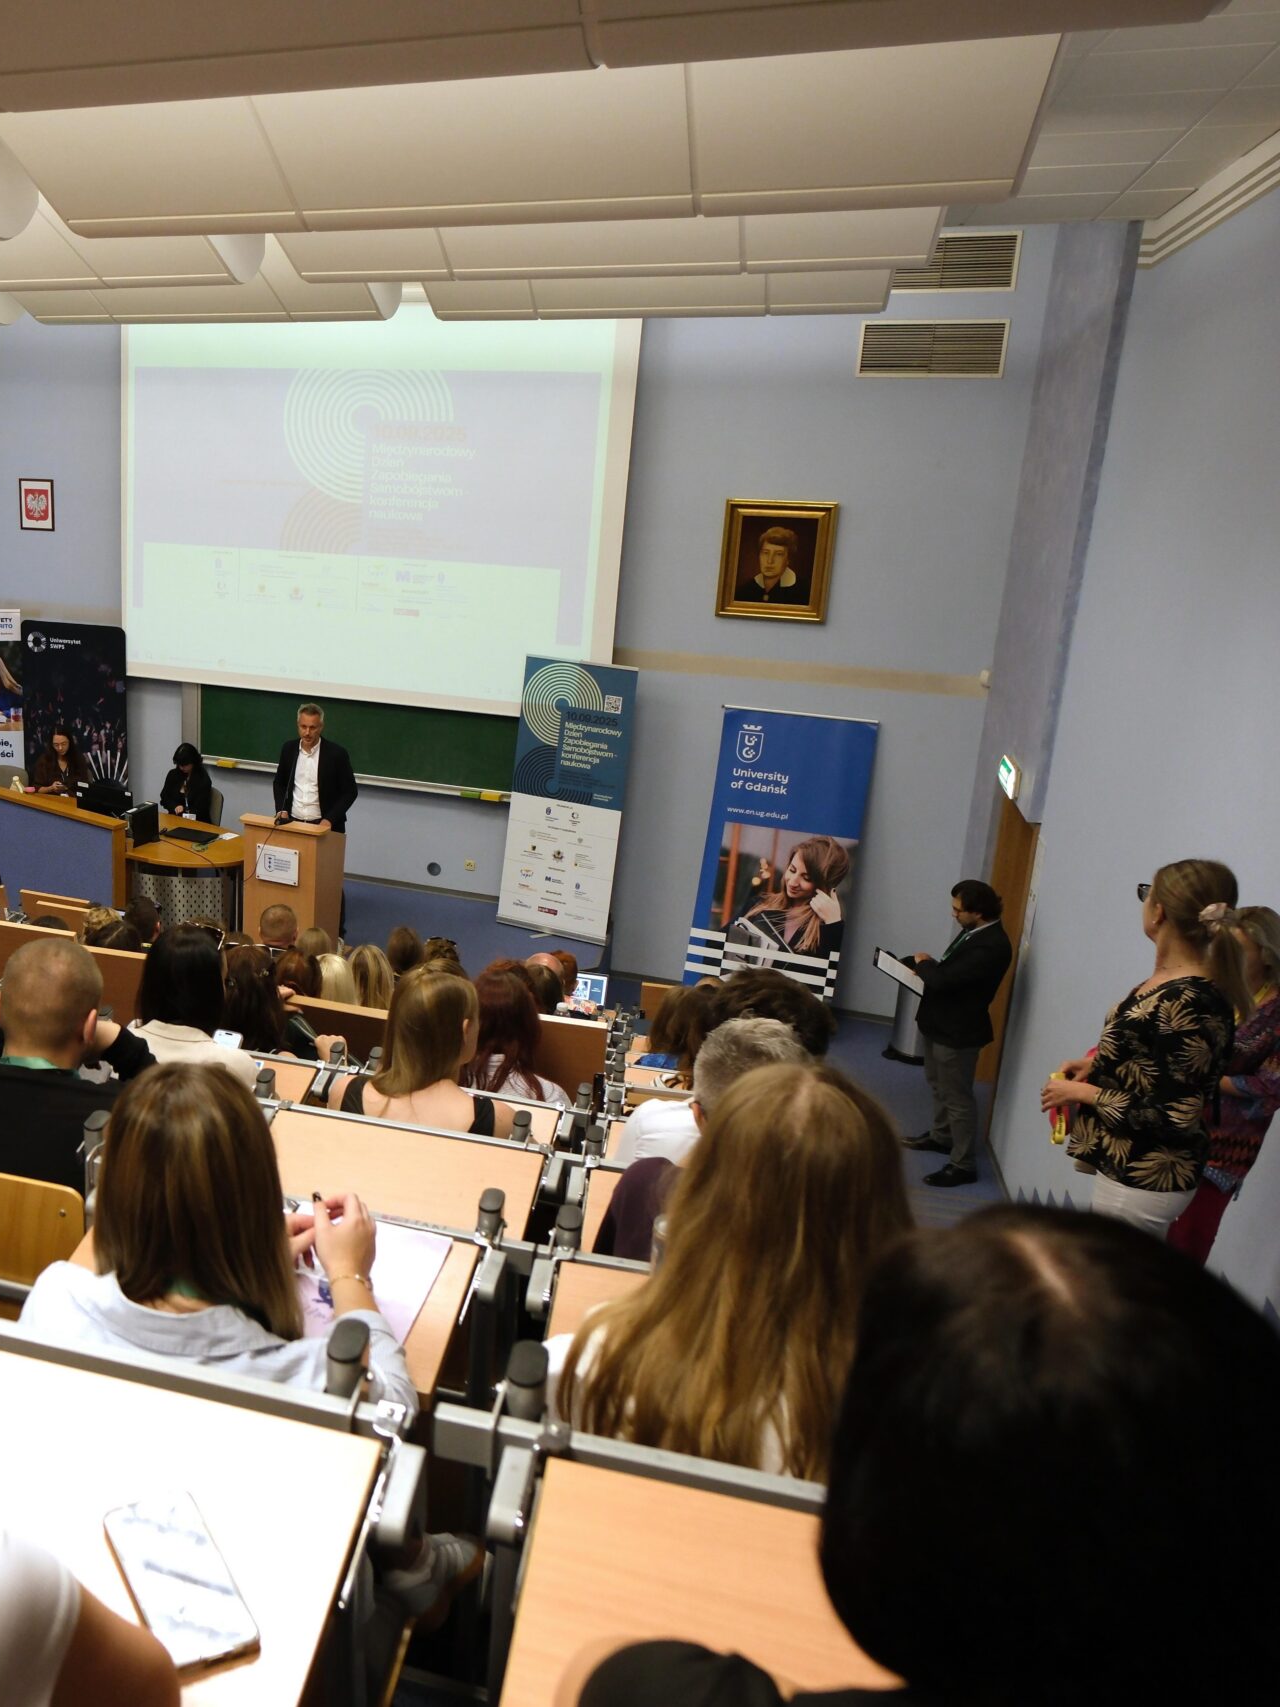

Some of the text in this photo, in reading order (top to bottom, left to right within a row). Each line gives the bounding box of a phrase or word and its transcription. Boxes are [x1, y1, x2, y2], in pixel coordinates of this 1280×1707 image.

[372, 443, 477, 460] Międzynarodowy
[371, 470, 453, 486] Zapobiegania
[369, 495, 439, 511] konferencja
[50, 637, 81, 645] Uniwersytet
[566, 711, 618, 727] 10.09.2025
[564, 729, 582, 738] Dzień
[565, 721, 622, 738] Międzynarodowy
[563, 737, 608, 750] Zapobiegania
[561, 751, 600, 764] konferencja
[562, 744, 614, 758] Samobójstwom
[560, 759, 591, 769] naukowa
[733, 768, 789, 784] University
[731, 780, 787, 795] of Gdańsk
[727, 806, 788, 820] www.en.ug.edu.pl
